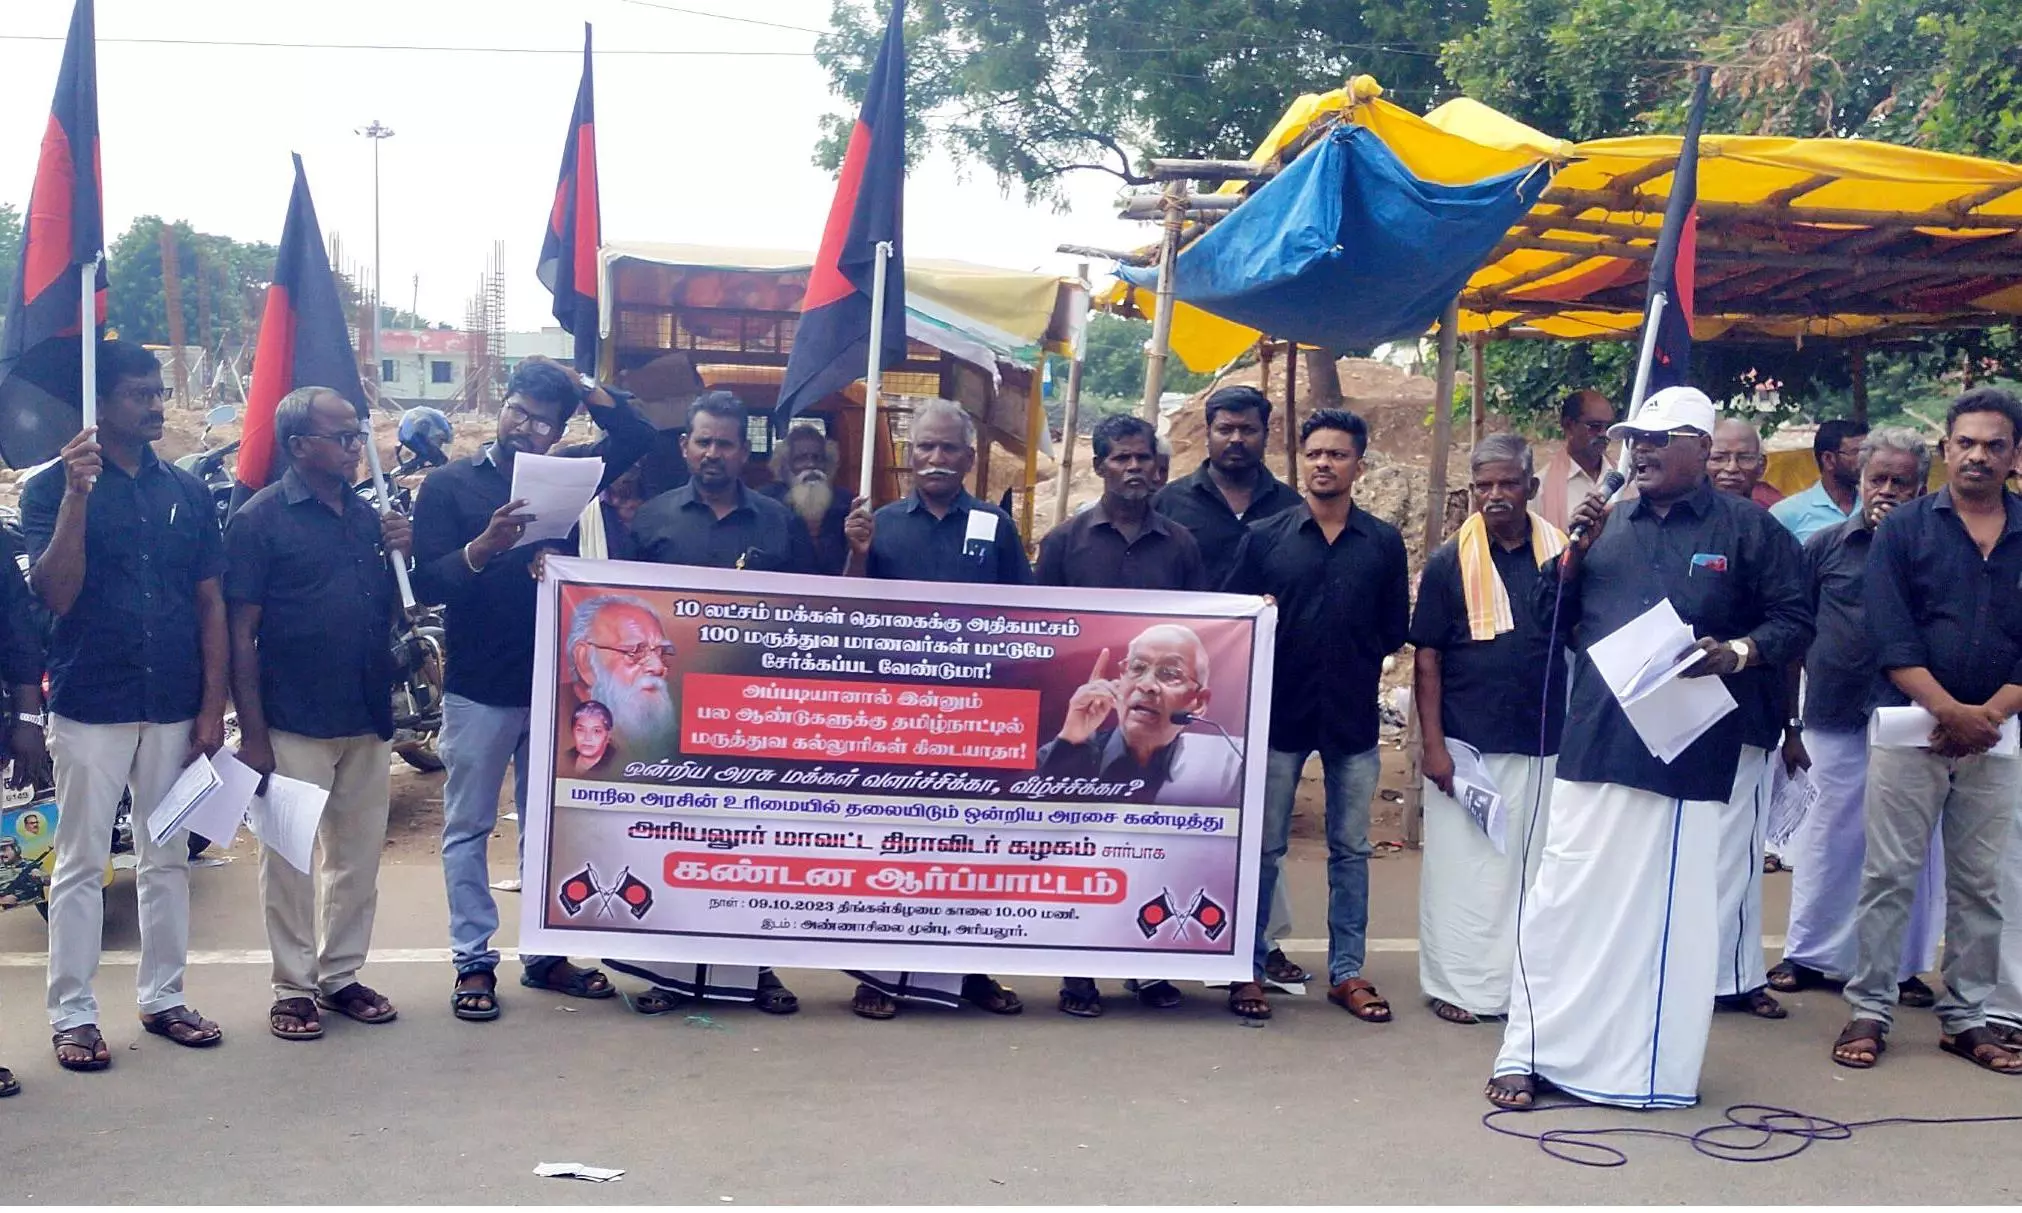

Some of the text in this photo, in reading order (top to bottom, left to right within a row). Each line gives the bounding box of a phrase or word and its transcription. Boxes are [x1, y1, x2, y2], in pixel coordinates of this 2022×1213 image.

[675, 600, 1080, 636] 10 லட்சம் மக்கள் தொகைக்கு அதிகபட்சம்
[700, 626, 1055, 659] 100 மருத்துவ மாணவர்கள் மட்டுமே
[762, 652, 992, 680] சேர்க்கப்பட வேண்டுமா!
[742, 682, 983, 712] அப்படியானால் இன்னும்
[697, 706, 1024, 736] பல ஆண்டுகளுக்கு தமிழ்நாட்டில்
[691, 729, 1027, 761] மருத்துவ கல்லூரிகள் கிடையாதா!
[624, 758, 711, 782] ஒன்றிய
[713, 766, 777, 784] அரசு
[780, 766, 859, 788] மக்கள்
[571, 788, 1224, 832] மாநில அரசின் உரிமையில் தலையிடும் ஒன்றிய அரசை கண்டித்து
[628, 821, 767, 850] அரியலூர்
[774, 830, 873, 850] மாவட்ட
[880, 831, 1001, 855] திராவிடர்
[1008, 836, 1097, 861] கழகம்
[672, 857, 1119, 897] கண்டன ஆர்ப்பாட்டம்
[749, 898, 834, 912] 09.10.2023
[945, 905, 991, 918] காலை
[995, 906, 1037, 918] 10.00
